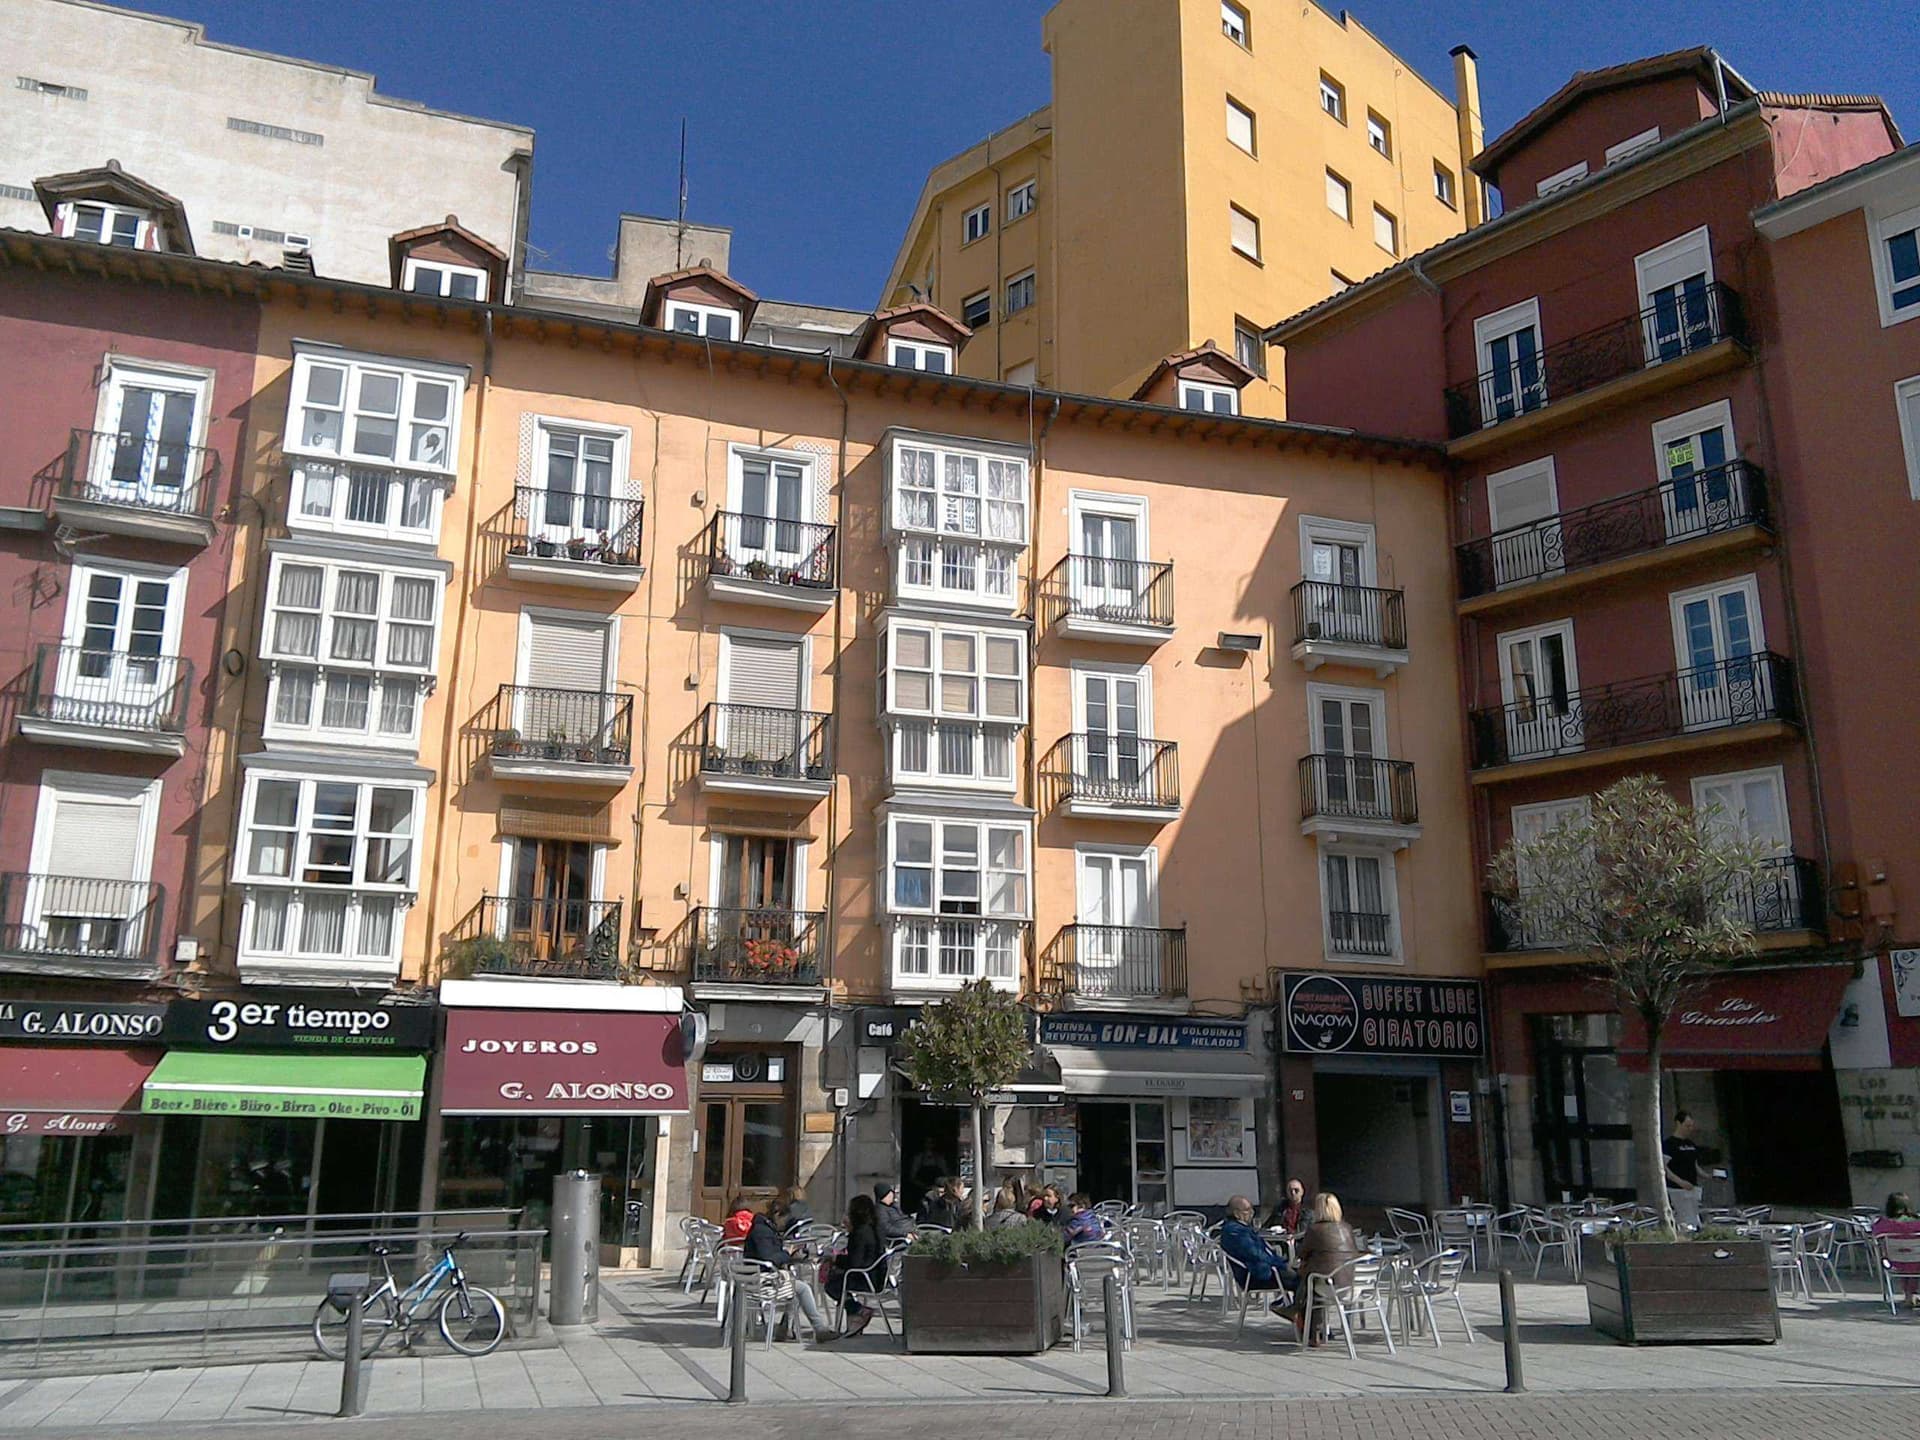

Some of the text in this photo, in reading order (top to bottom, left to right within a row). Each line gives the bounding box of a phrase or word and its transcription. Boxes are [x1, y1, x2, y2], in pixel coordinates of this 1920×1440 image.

[1362, 984, 1477, 1015] BUFFET LIBRE
[22, 1011, 47, 1034] G.
[50, 1012, 164, 1036] ALONSO
[207, 1000, 391, 1042] 3er tiempo
[1294, 1012, 1353, 1028] NAGOYA
[1680, 1009, 1779, 1026] Girasoles
[868, 1023, 893, 1037] Café
[1048, 1022, 1093, 1032] PRENSA
[1101, 1024, 1179, 1045] GON-BAL
[1182, 1027, 1242, 1038] GOLOSINAS
[1363, 1017, 1479, 1049] GIRATORIO
[293, 1035, 329, 1043] TIENDA
[345, 1036, 395, 1045] CERVEZAS
[1045, 1032, 1098, 1043] REVISTAS
[1191, 1038, 1240, 1048] HELADOS
[462, 1040, 598, 1054] JOYEROS
[500, 1083, 674, 1100] G. ALONSO
[150, 1098, 182, 1110] Beer
[282, 1101, 316, 1113] Birra
[362, 1103, 389, 1115] Pivo
[6, 1113, 117, 1133] G. Alonso
